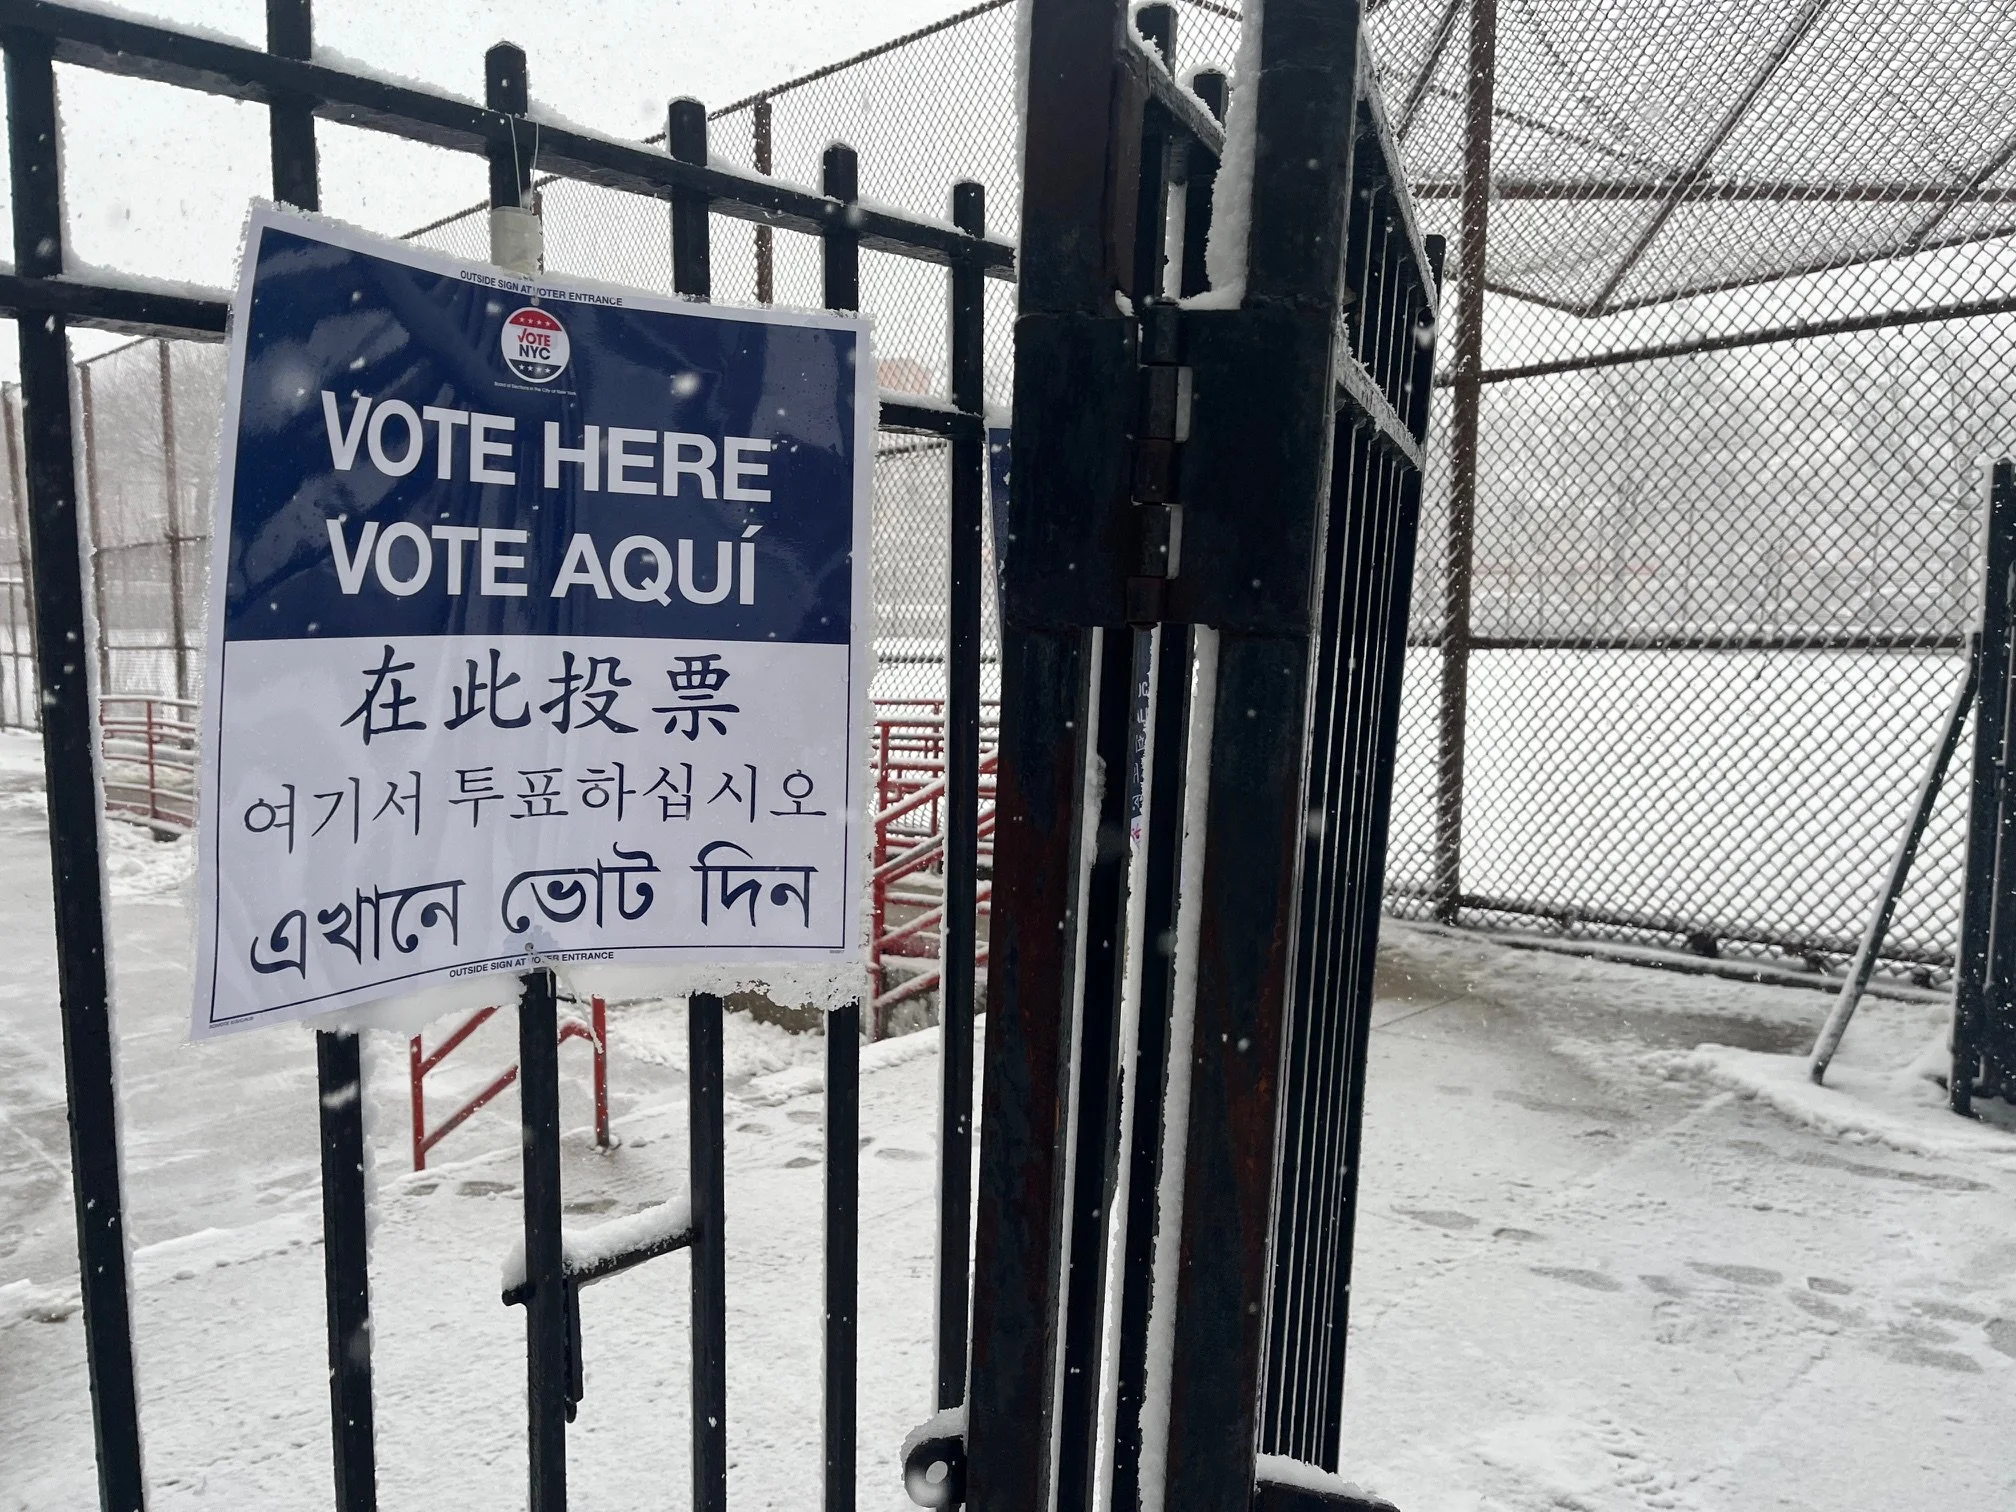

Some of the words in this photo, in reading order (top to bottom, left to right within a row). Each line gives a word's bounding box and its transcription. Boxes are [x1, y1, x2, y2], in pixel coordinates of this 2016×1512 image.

[460, 270, 496, 287] OUTSIDE
[498, 280, 518, 291] SIGN
[520, 284, 532, 294] AT
[568, 291, 623, 306] ENTRANCE
[517, 328, 551, 347] VOTE
[519, 344, 551, 360] NYC
[321, 391, 516, 486] VOTE
[545, 421, 771, 502] HERE
[327, 516, 528, 597] VOTE
[551, 524, 764, 607] AQUÍ
[340, 643, 740, 746] 在此投票
[243, 769, 422, 854] 여기서
[448, 761, 828, 828] 투표하십시오
[250, 879, 467, 980] এখানে
[501, 841, 662, 934] ভোট
[689, 840, 819, 929] দিন
[449, 963, 489, 978] OUTSIDE
[490, 959, 513, 970] SIGN
[515, 957, 526, 967] AT
[562, 951, 615, 962] ENTRANCE
